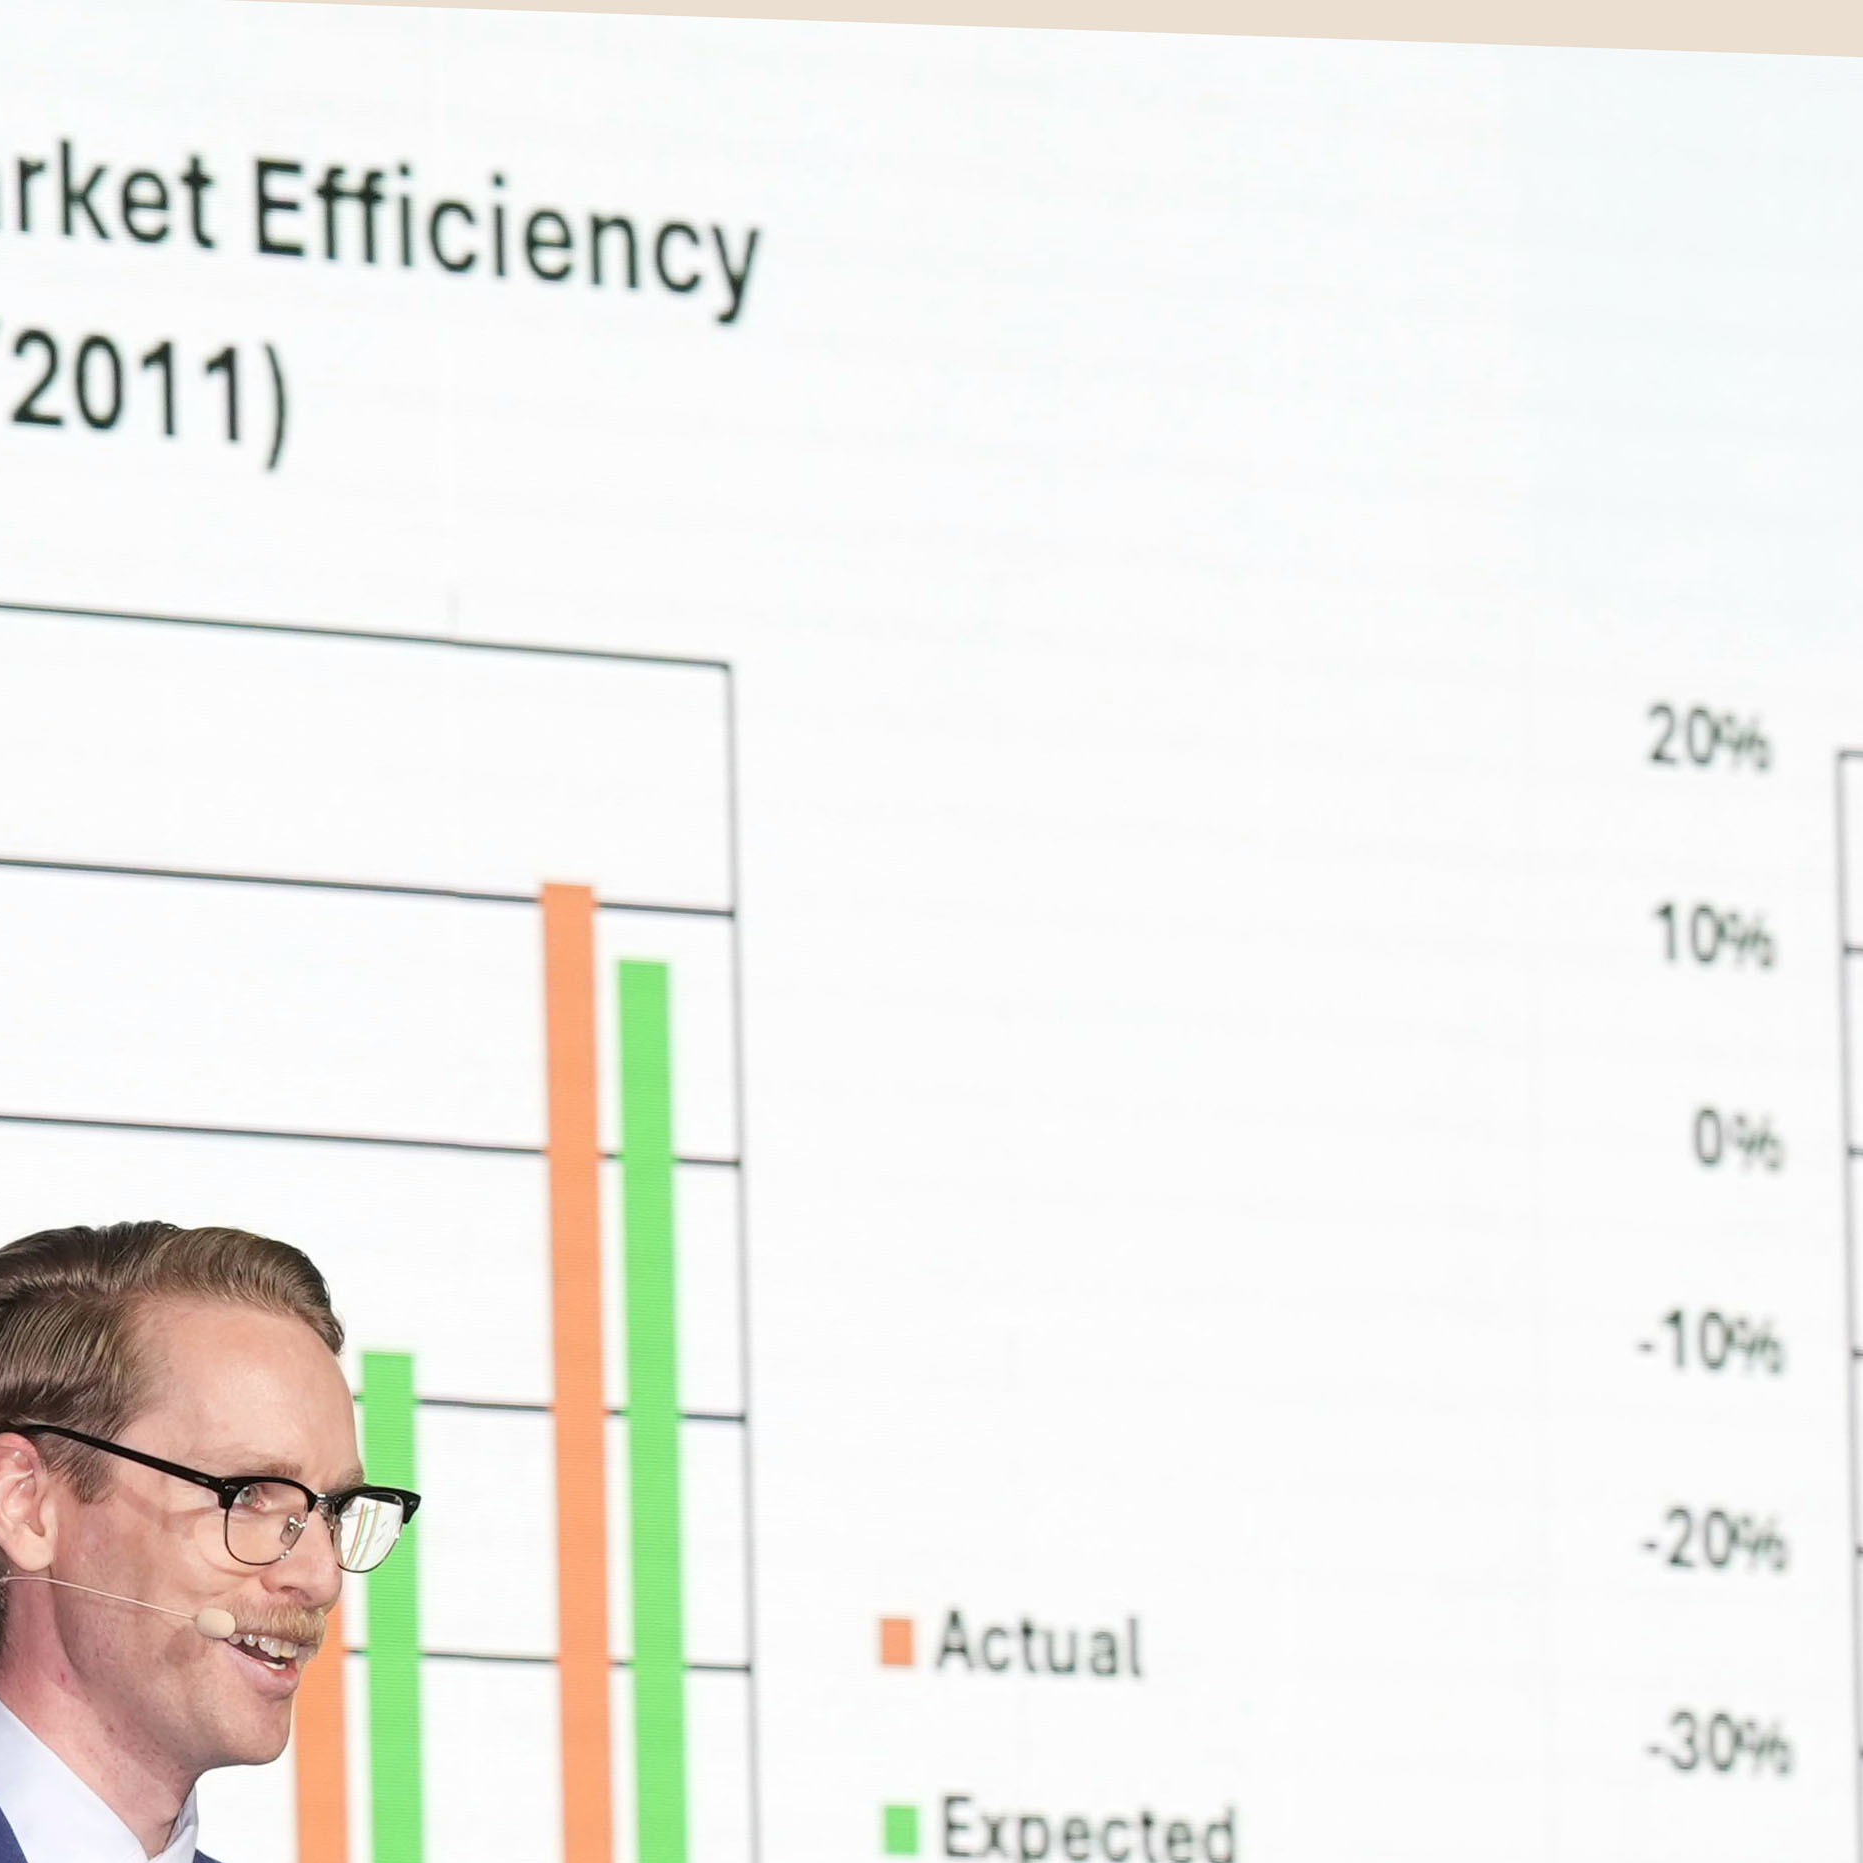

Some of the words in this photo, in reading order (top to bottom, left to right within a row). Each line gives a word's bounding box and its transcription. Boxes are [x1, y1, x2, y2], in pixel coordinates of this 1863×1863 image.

[255, 158, 759, 326] Efficiency
[1648, 702, 1770, 771] 20%
[1654, 902, 1774, 969] 10%
[1693, 1106, 1782, 1172] 0%
[1639, 1308, 1783, 1374] -10%
[1643, 1505, 1787, 1571] -20%
[935, 1609, 1141, 1678] Actual
[1648, 1709, 1791, 1776] -30%
